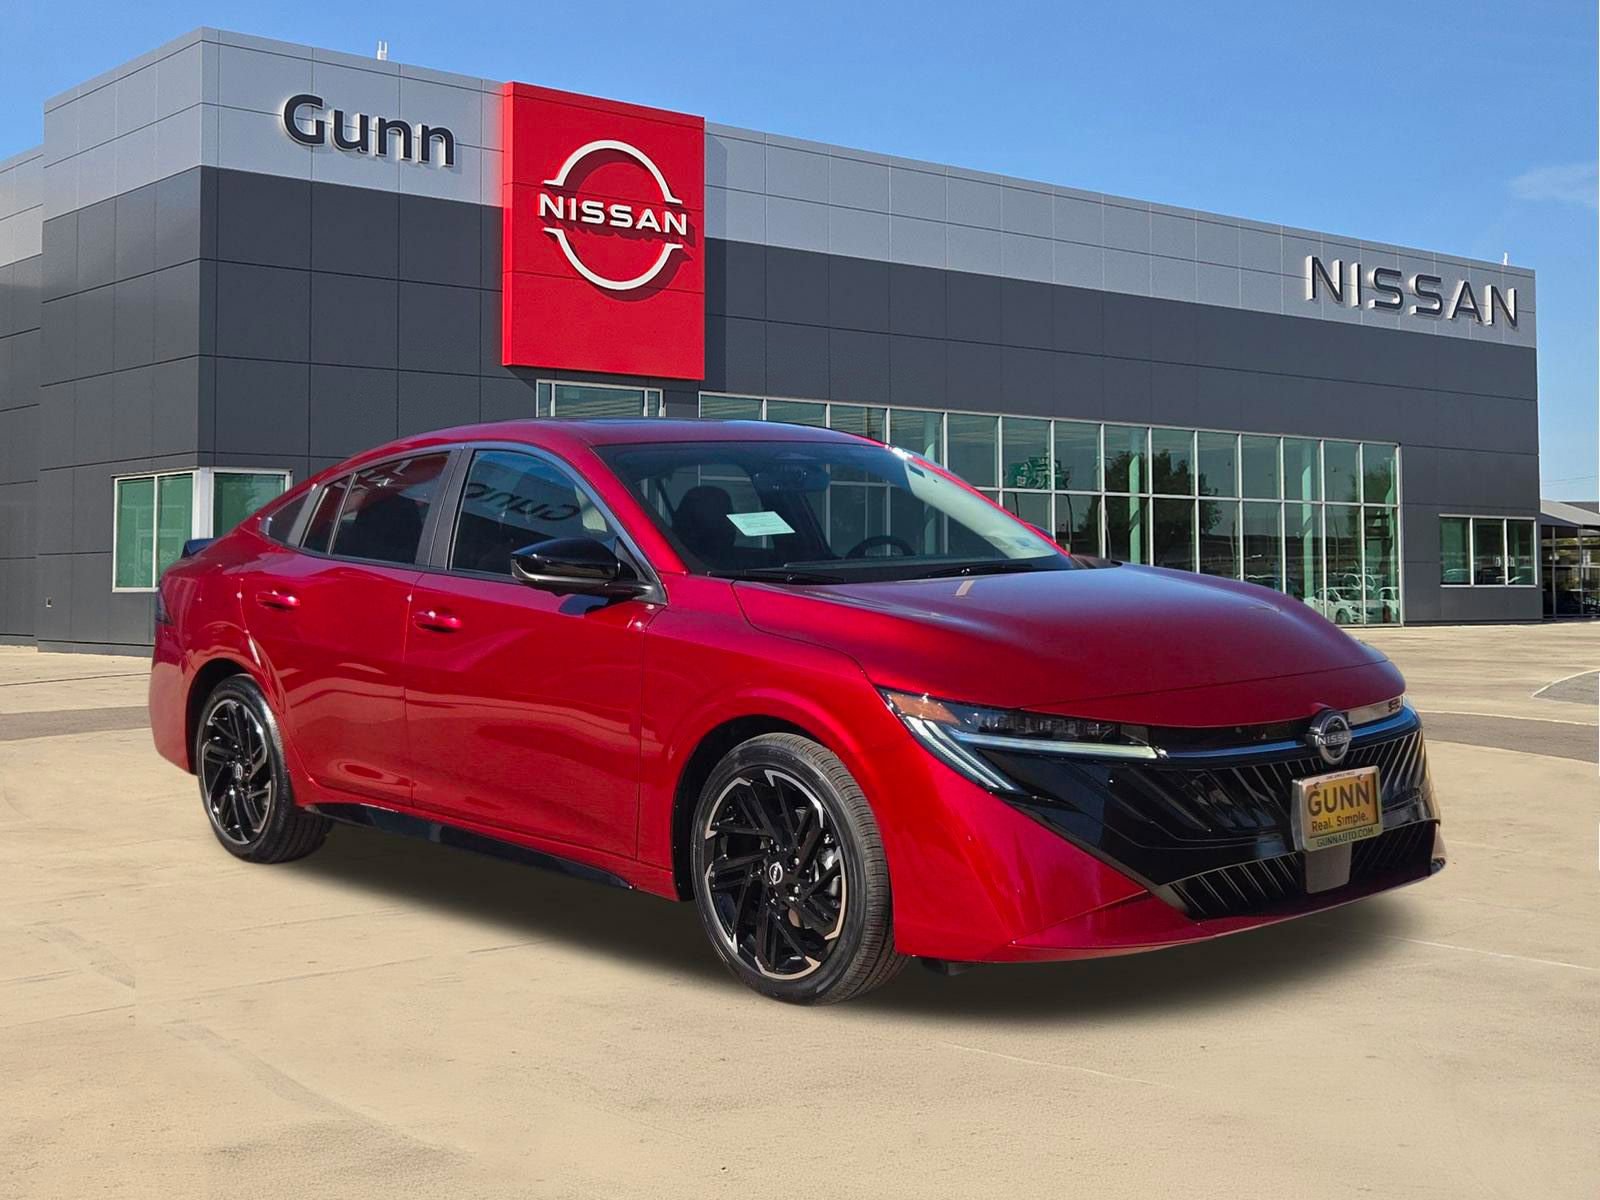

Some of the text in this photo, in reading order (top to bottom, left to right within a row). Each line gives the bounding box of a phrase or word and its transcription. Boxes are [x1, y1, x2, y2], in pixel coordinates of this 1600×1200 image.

[281, 93, 456, 168] Gunn
[538, 193, 687, 236] NISSAN
[1305, 255, 1519, 328] NISSAN
[1318, 732, 1351, 745] NISS
[1308, 781, 1370, 817] GUNN
[1311, 811, 1369, 833] Real. Simple.
[1317, 826, 1374, 847] GUNNAUTO.COM
